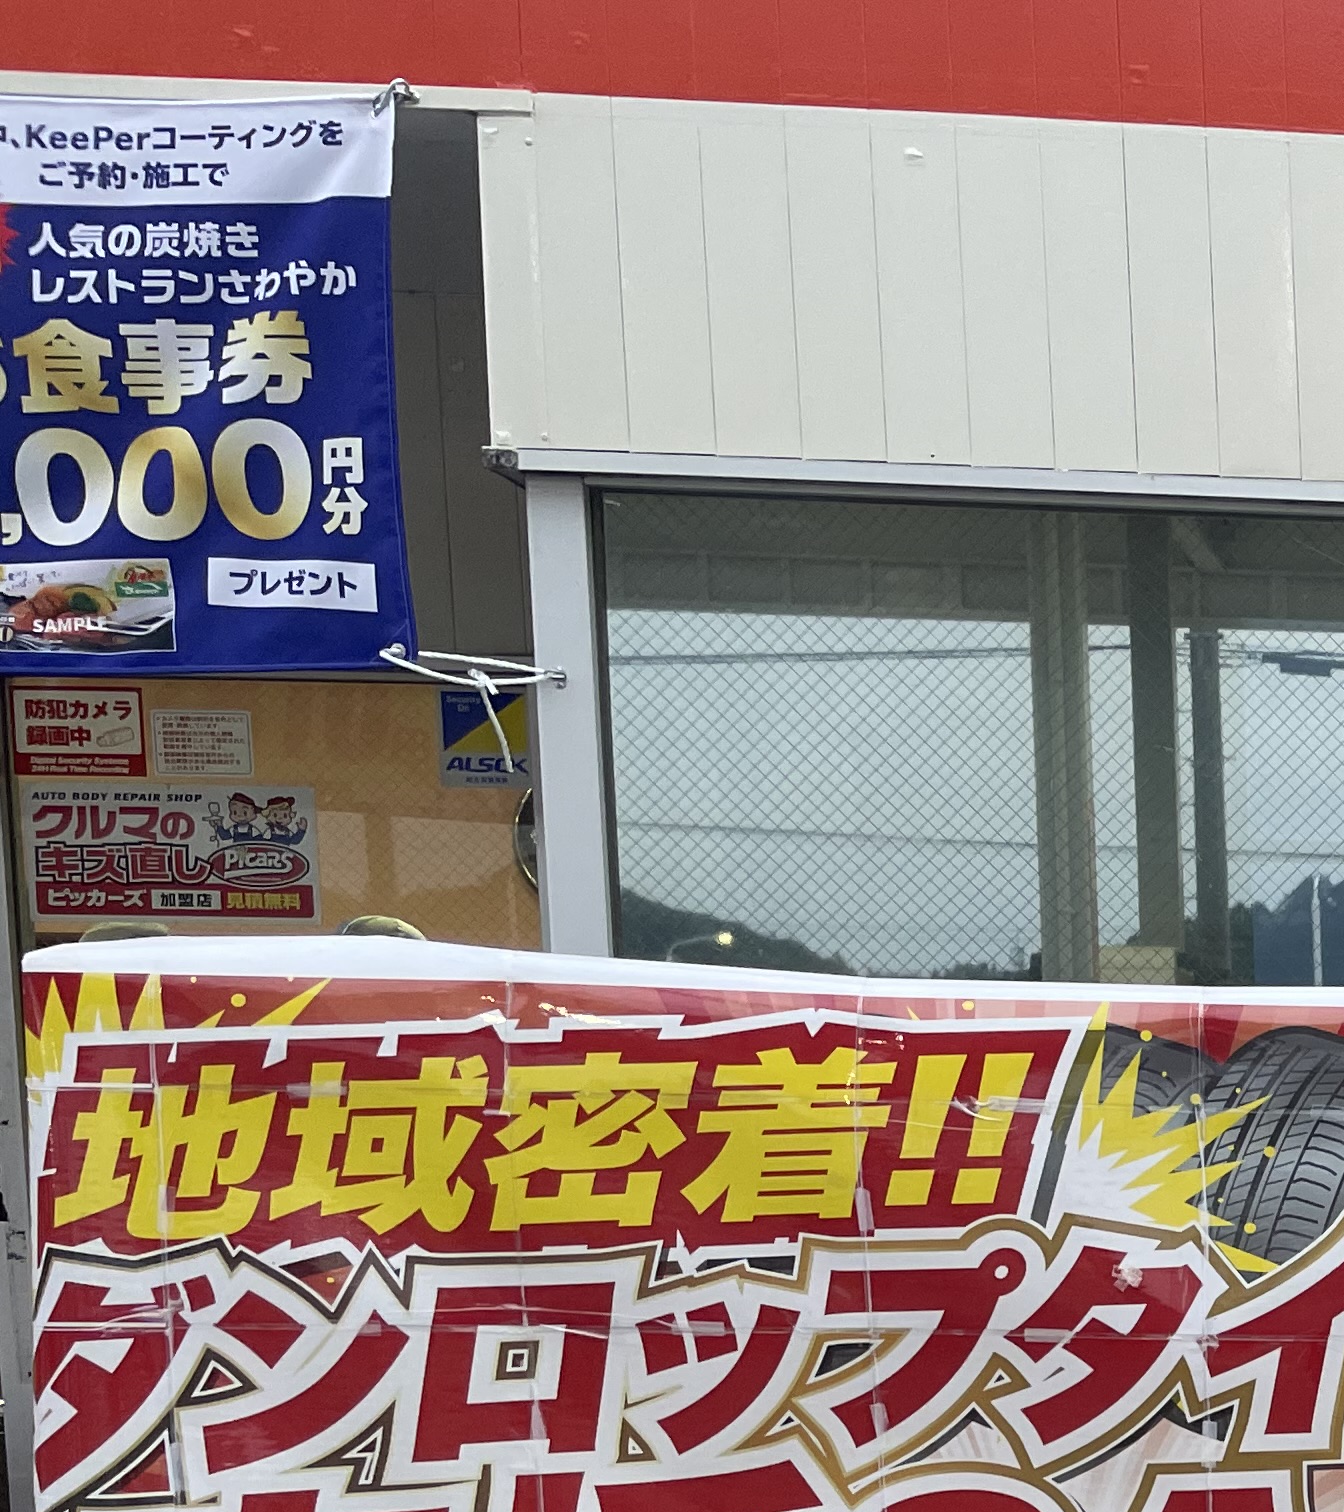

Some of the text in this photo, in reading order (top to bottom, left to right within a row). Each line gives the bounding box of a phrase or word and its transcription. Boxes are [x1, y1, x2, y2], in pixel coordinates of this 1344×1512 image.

[39, 161, 229, 189] ご予約・施工で
[28, 222, 259, 258] 人気の炭焼き
[31, 261, 356, 304] レストランさわやか
[0, 310, 313, 416] 食事券
[230, 570, 357, 598] プレゼント
[33, 616, 109, 633] SAMPLE
[25, 699, 132, 720] 防犯カメラ
[27, 726, 91, 747] 録画中
[32, 792, 202, 802] AUTO BODY REPAIR SHOP
[32, 805, 195, 843] クルマの
[38, 844, 211, 884] キズ直し
[48, 888, 147, 907] ピッカーズ
[160, 892, 212, 907] 加盟店
[52, 1049, 1035, 1240] 地域密着!!
